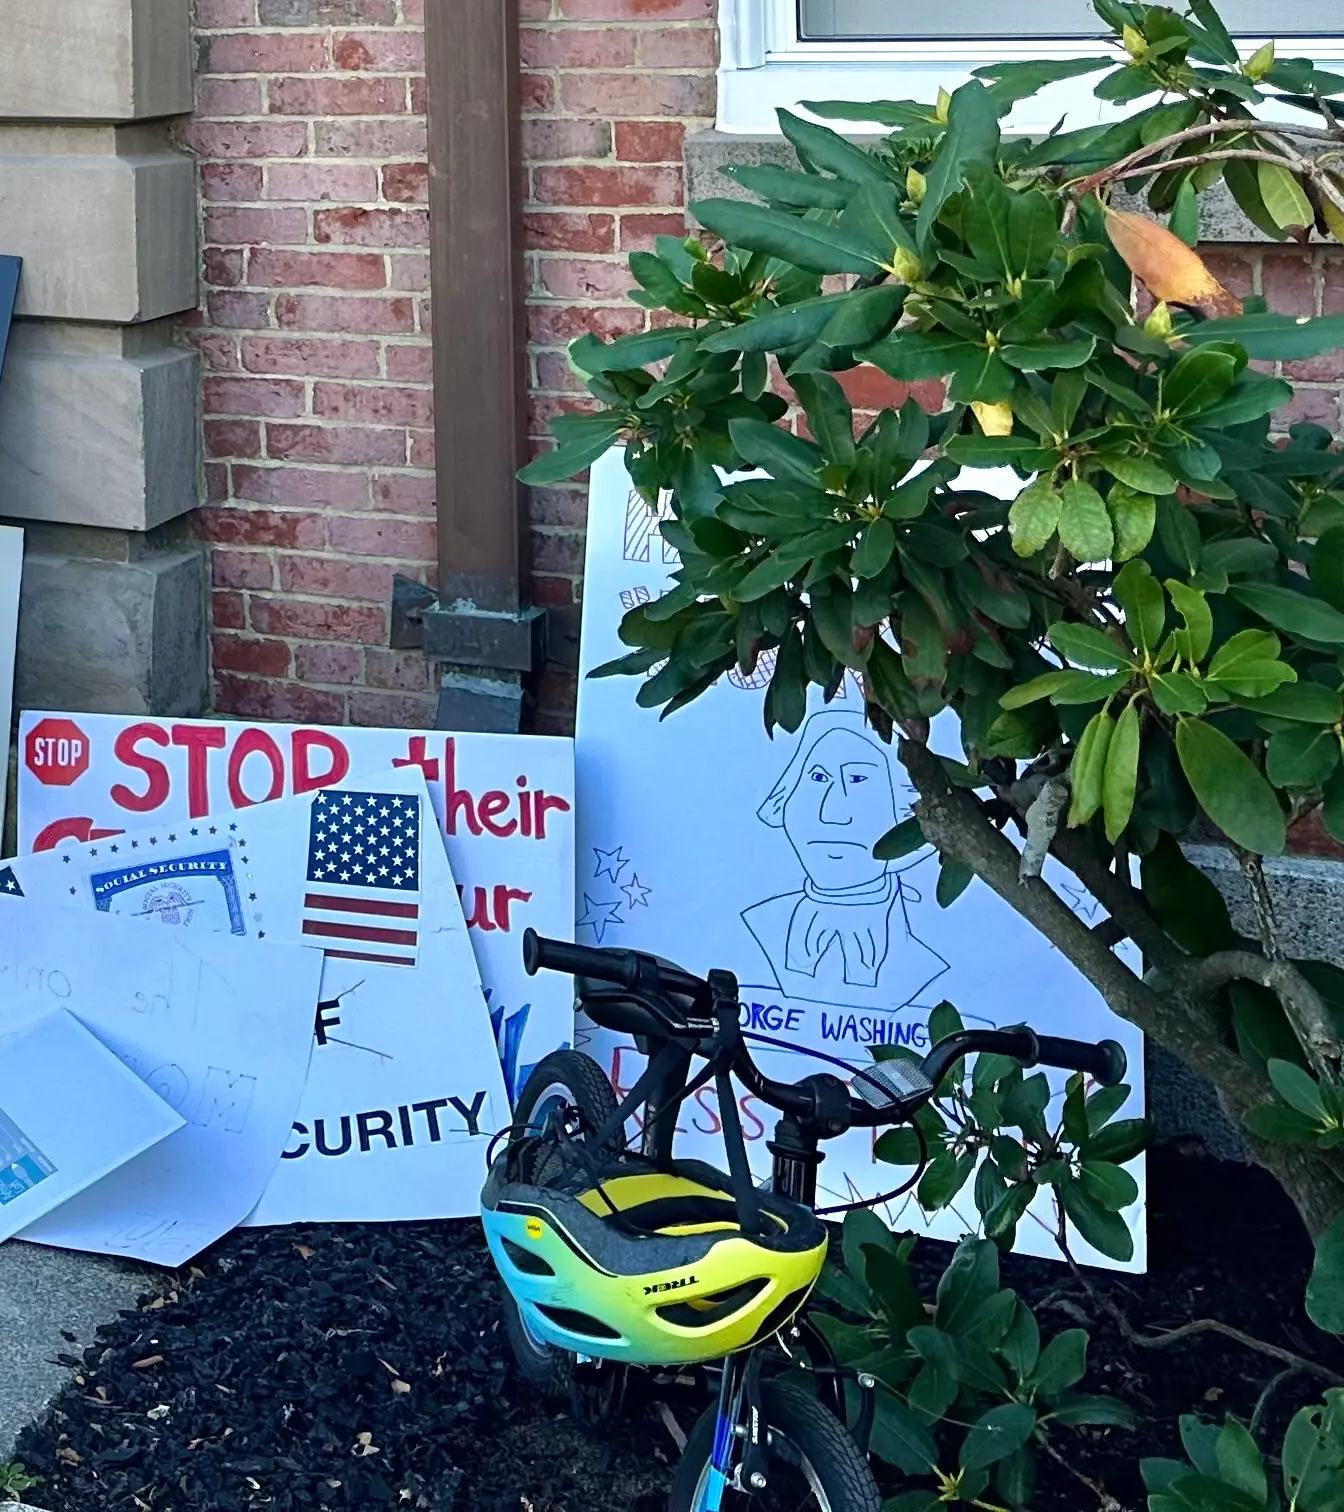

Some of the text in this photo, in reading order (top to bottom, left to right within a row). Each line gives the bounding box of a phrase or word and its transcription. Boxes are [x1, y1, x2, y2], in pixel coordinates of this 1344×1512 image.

[33, 737, 82, 768] STOP
[109, 722, 571, 839] STOP their
[95, 861, 228, 894] SOCIAL SECURITY
[465, 884, 534, 932] ur
[314, 999, 341, 1045] F
[740, 1001, 929, 1049] ORGE WASHING
[280, 1090, 487, 1160] CURITY
[643, 1275, 700, 1296] TREK
